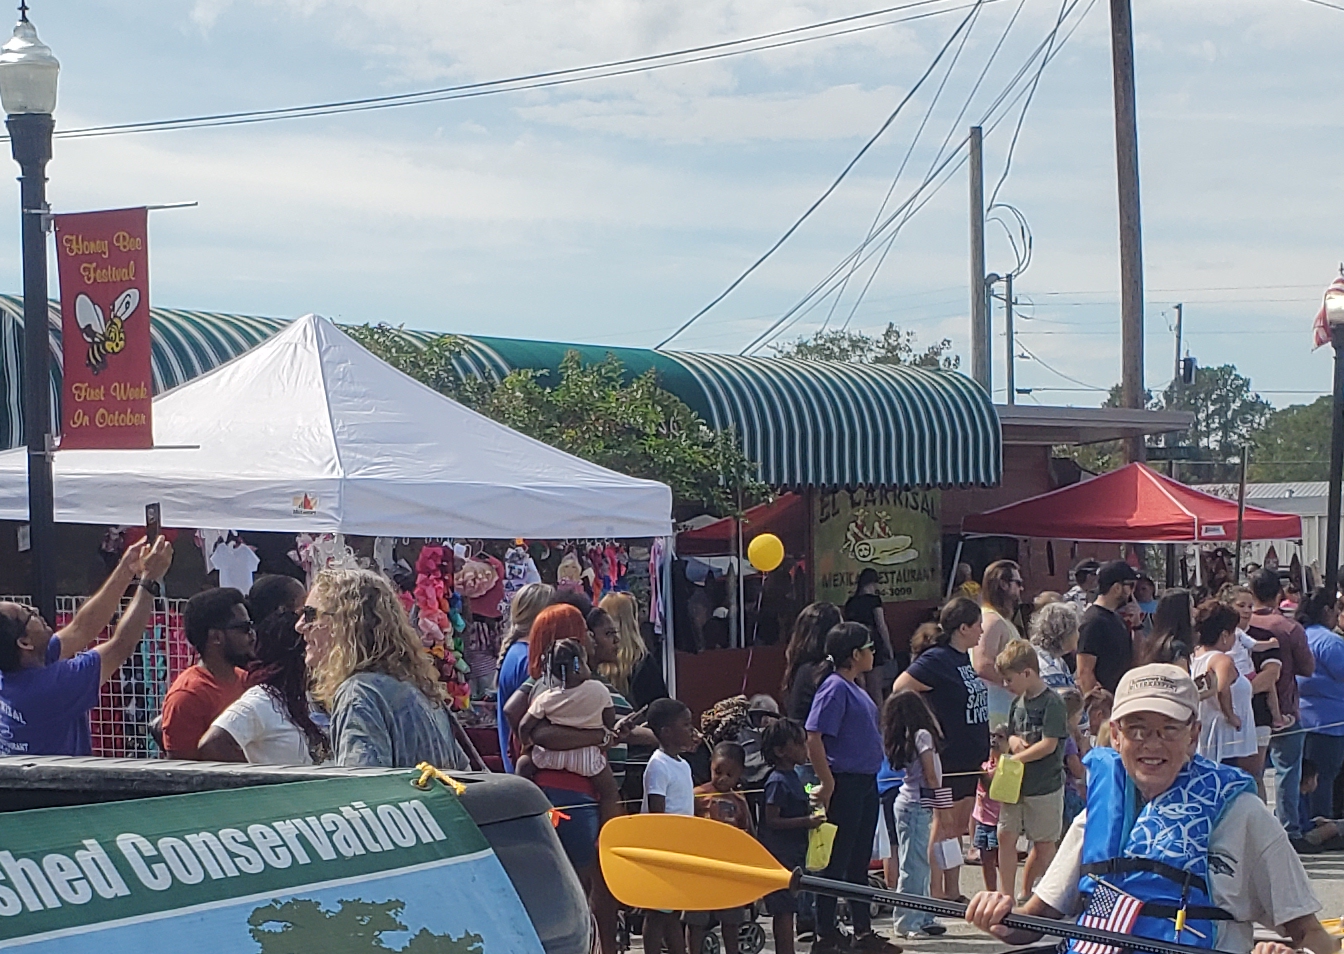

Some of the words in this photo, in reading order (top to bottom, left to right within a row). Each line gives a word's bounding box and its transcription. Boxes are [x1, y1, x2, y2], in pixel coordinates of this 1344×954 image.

[63, 234, 109, 258] Honey
[113, 231, 142, 251] Bee
[80, 261, 136, 285] Festival
[72, 382, 105, 402] First
[110, 381, 149, 401] Week
[70, 409, 89, 428] In
[95, 408, 147, 427] October
[114, 798, 448, 892] Conservation
